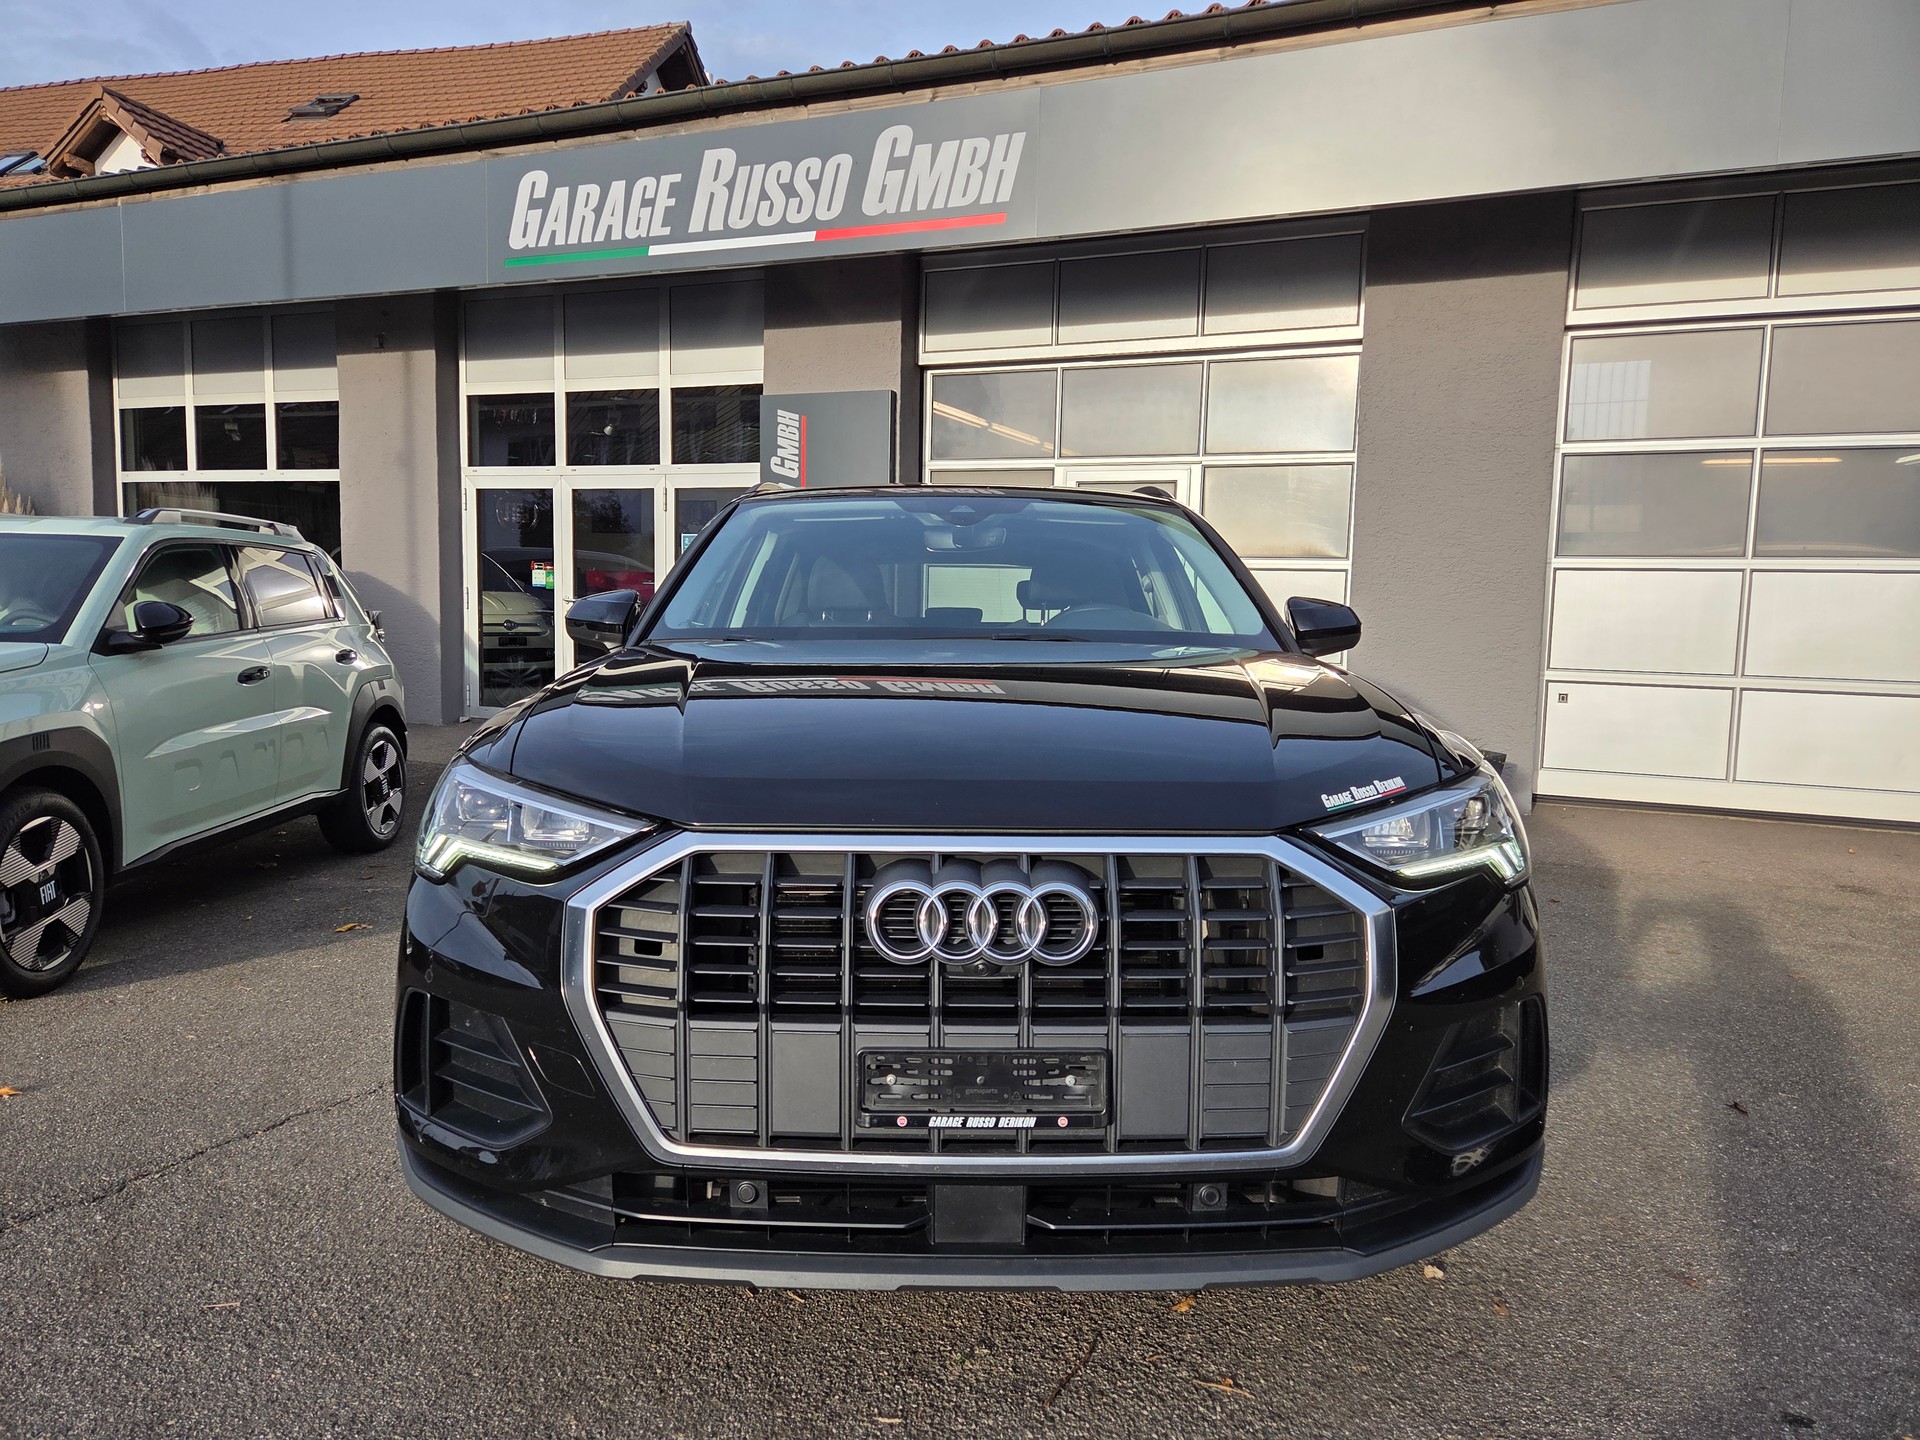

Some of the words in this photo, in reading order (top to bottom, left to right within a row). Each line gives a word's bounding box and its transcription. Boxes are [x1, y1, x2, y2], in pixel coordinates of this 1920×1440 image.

[508, 170, 682, 250] GARAGE
[688, 147, 853, 233] RUSSO
[861, 124, 1027, 216] GMBH
[770, 409, 799, 479] GMBH
[1321, 791, 1354, 808] GARAGE
[1350, 785, 1378, 801] RUSSO
[40, 880, 57, 905] FIAT
[928, 1116, 963, 1128] GARAGE
[966, 1116, 997, 1128] RUSSO
[998, 1116, 1037, 1128] BERIKON
